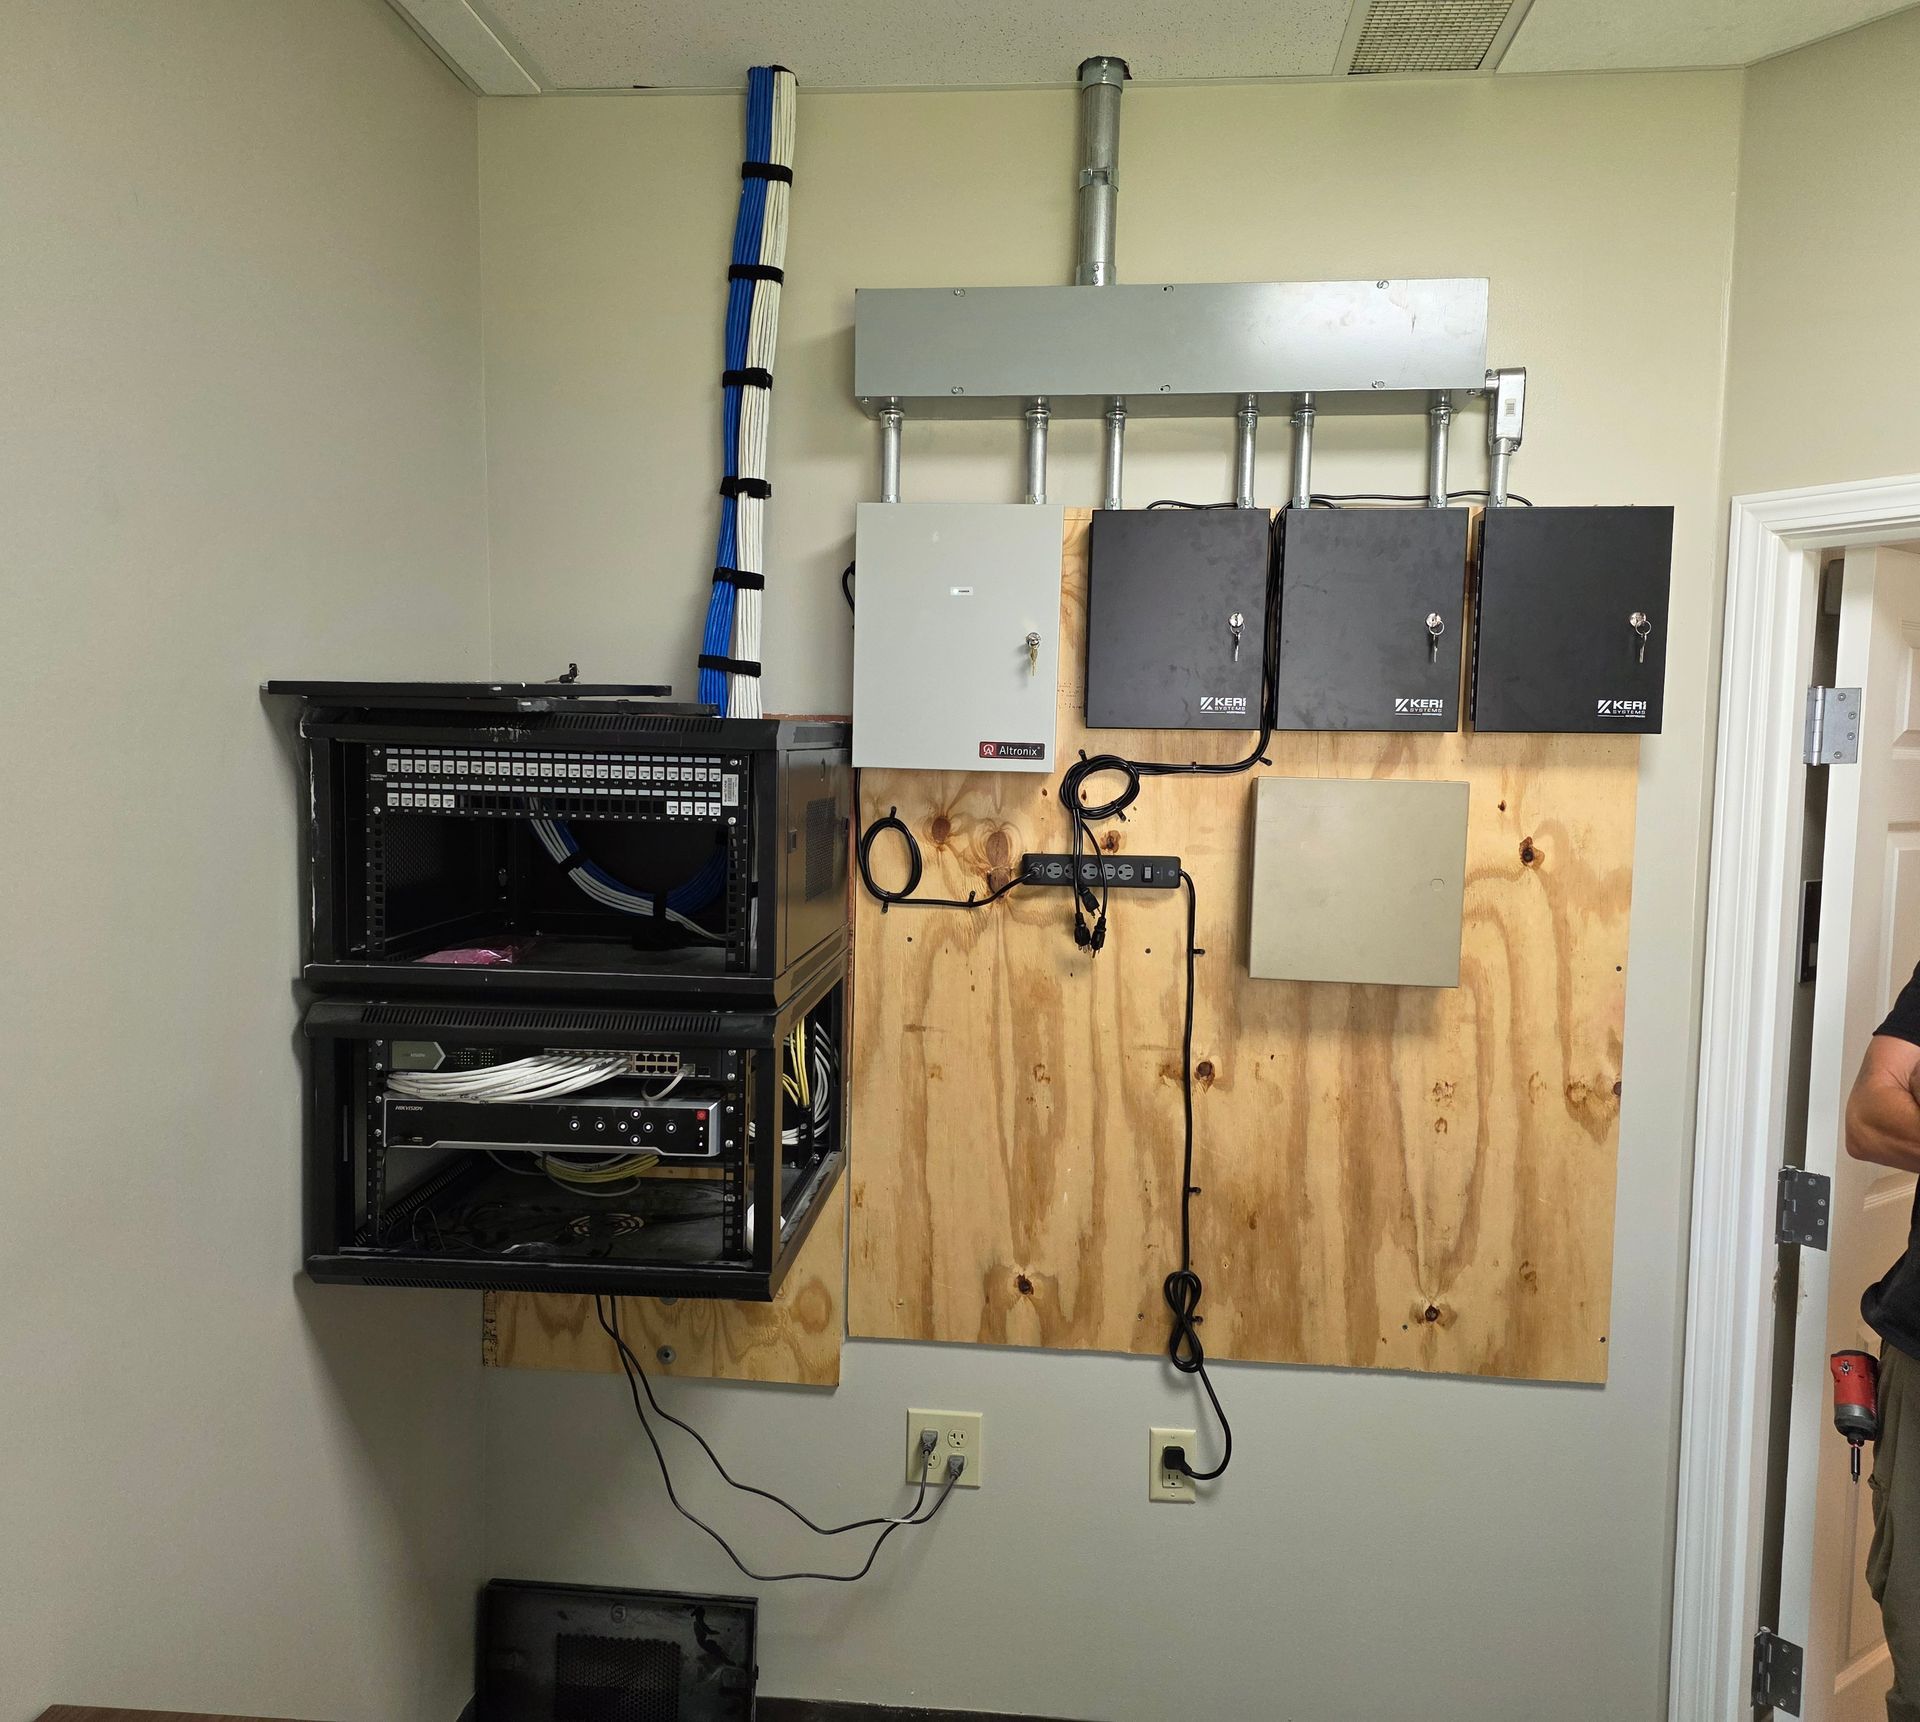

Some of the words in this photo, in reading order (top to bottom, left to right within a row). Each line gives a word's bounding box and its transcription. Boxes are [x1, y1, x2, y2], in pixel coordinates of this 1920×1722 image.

[1214, 697, 1247, 707] KERI
[1410, 698, 1443, 709] KERI
[1612, 700, 1647, 710] KERI
[999, 745, 1037, 756] Altronix
